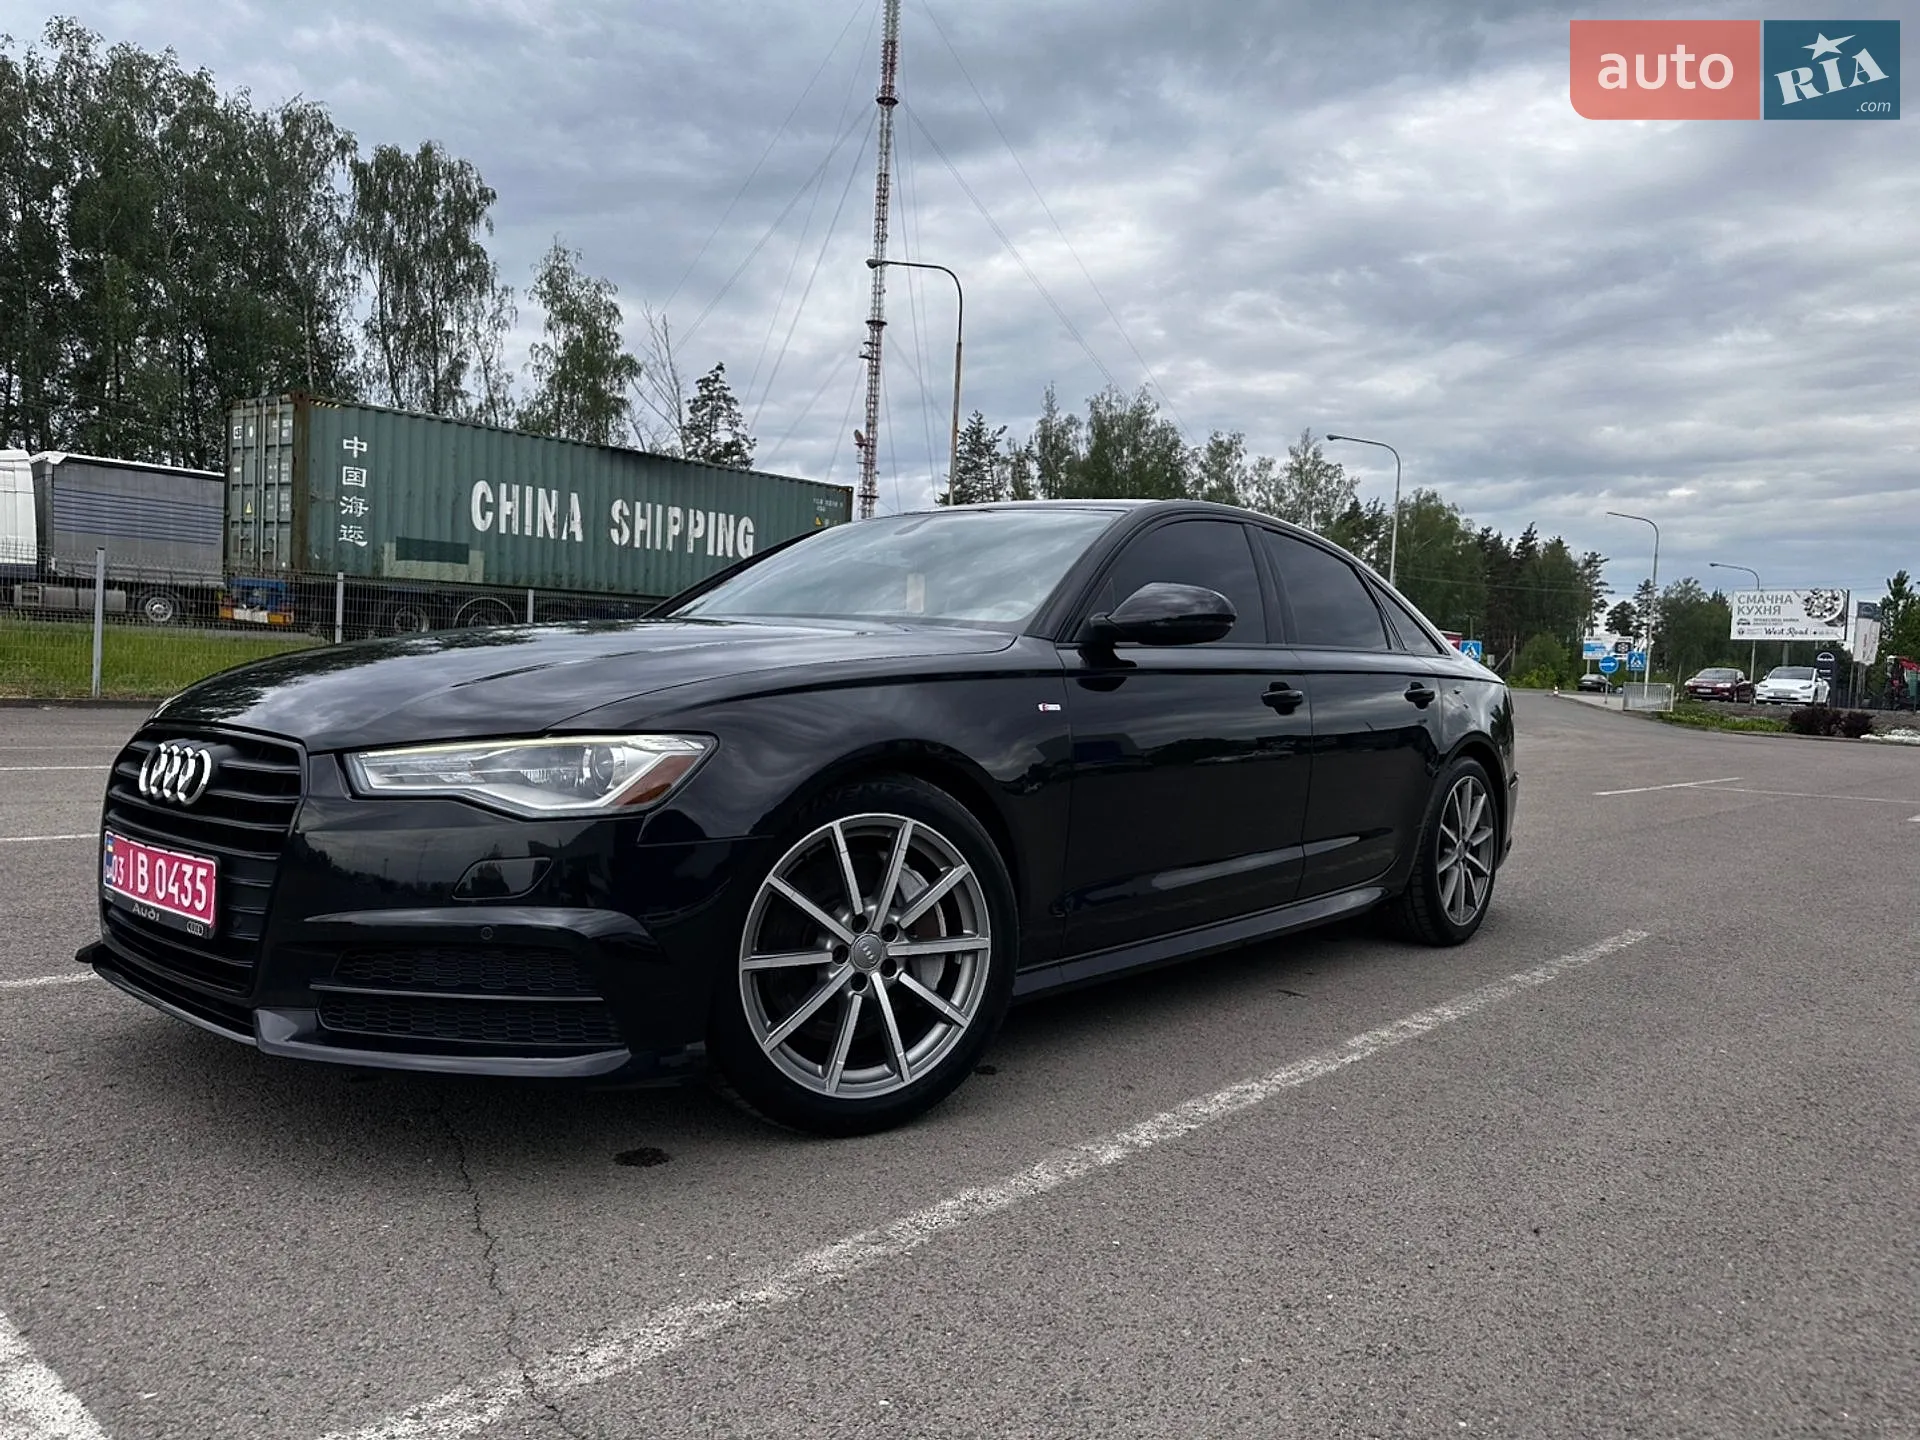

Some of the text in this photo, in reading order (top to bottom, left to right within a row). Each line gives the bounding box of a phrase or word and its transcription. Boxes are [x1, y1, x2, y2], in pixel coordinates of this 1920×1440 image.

[338, 436, 369, 547] 中国海运
[471, 480, 755, 559] CHINA SHIPPING
[1737, 594, 1793, 604] СМАЧНА
[1737, 605, 1781, 615] КУХНЯ
[112, 855, 124, 885] 03
[155, 858, 208, 911] 0435
